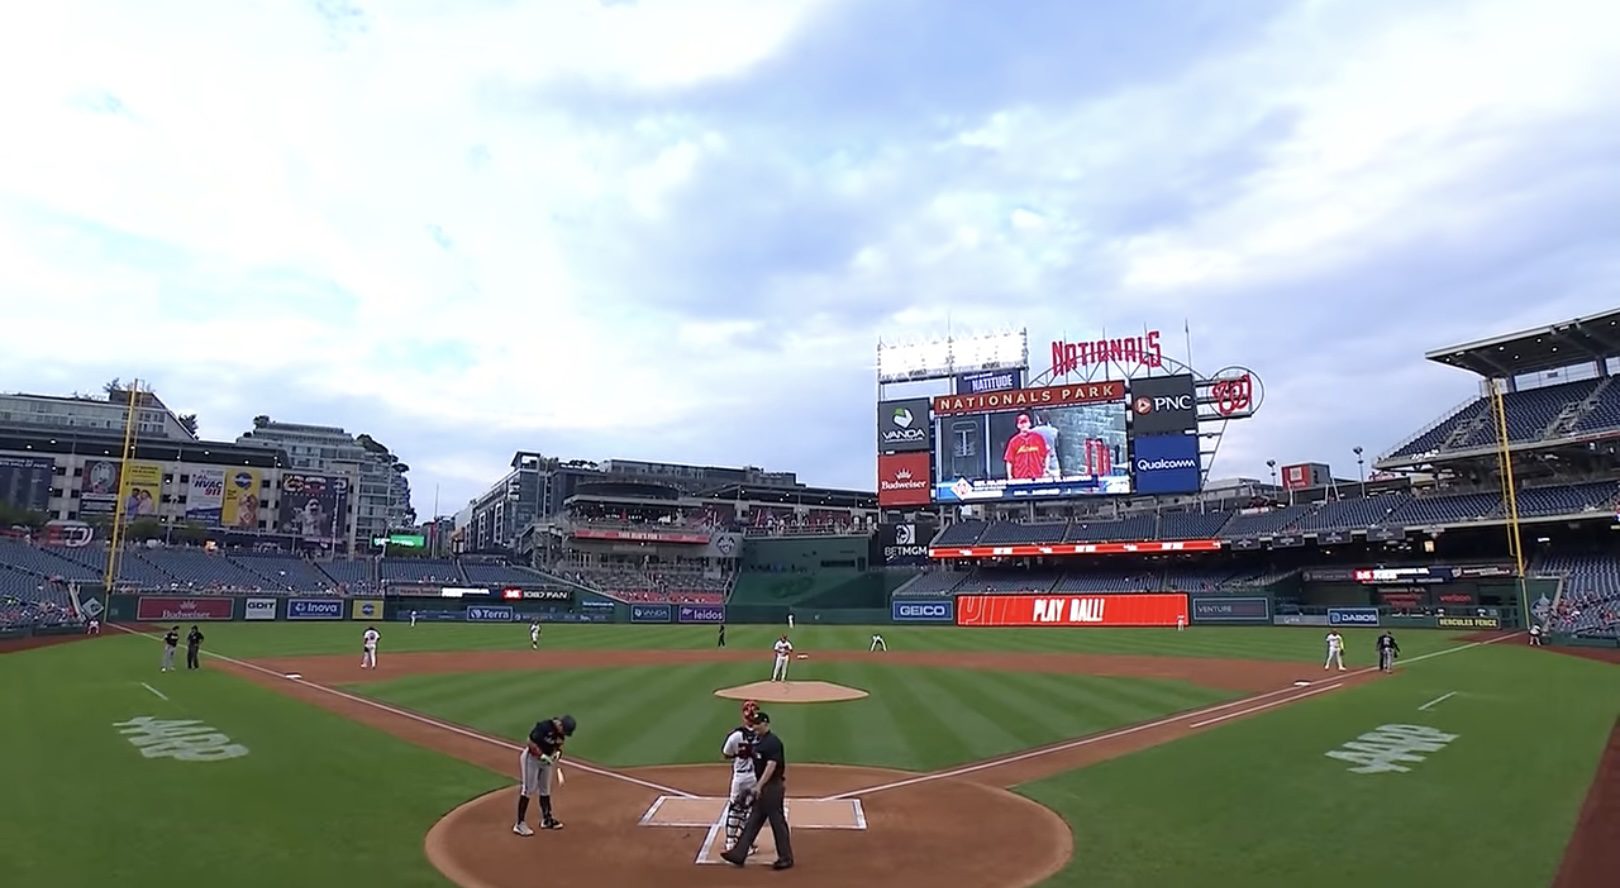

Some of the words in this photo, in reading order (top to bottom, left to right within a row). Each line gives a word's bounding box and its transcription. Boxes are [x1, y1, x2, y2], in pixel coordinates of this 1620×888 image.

[1051, 331, 1162, 376] NATIONALS
[971, 375, 1014, 392] NATITUDE
[940, 390, 1051, 410] NATIONALS
[1061, 385, 1115, 399] PARK
[1153, 395, 1192, 412] PNC
[1137, 458, 1196, 471] Qualcomm
[194, 480, 223, 489] HVAC
[881, 480, 927, 491] Budweiser
[884, 545, 928, 557] BETMGM
[247, 601, 275, 610] GDIT
[308, 602, 338, 613] Inova
[900, 605, 945, 617] GEICO
[1033, 599, 1065, 622] PLAY
[1070, 598, 1105, 622] BALL!
[483, 609, 509, 619] Terra
[694, 609, 724, 620] leidos
